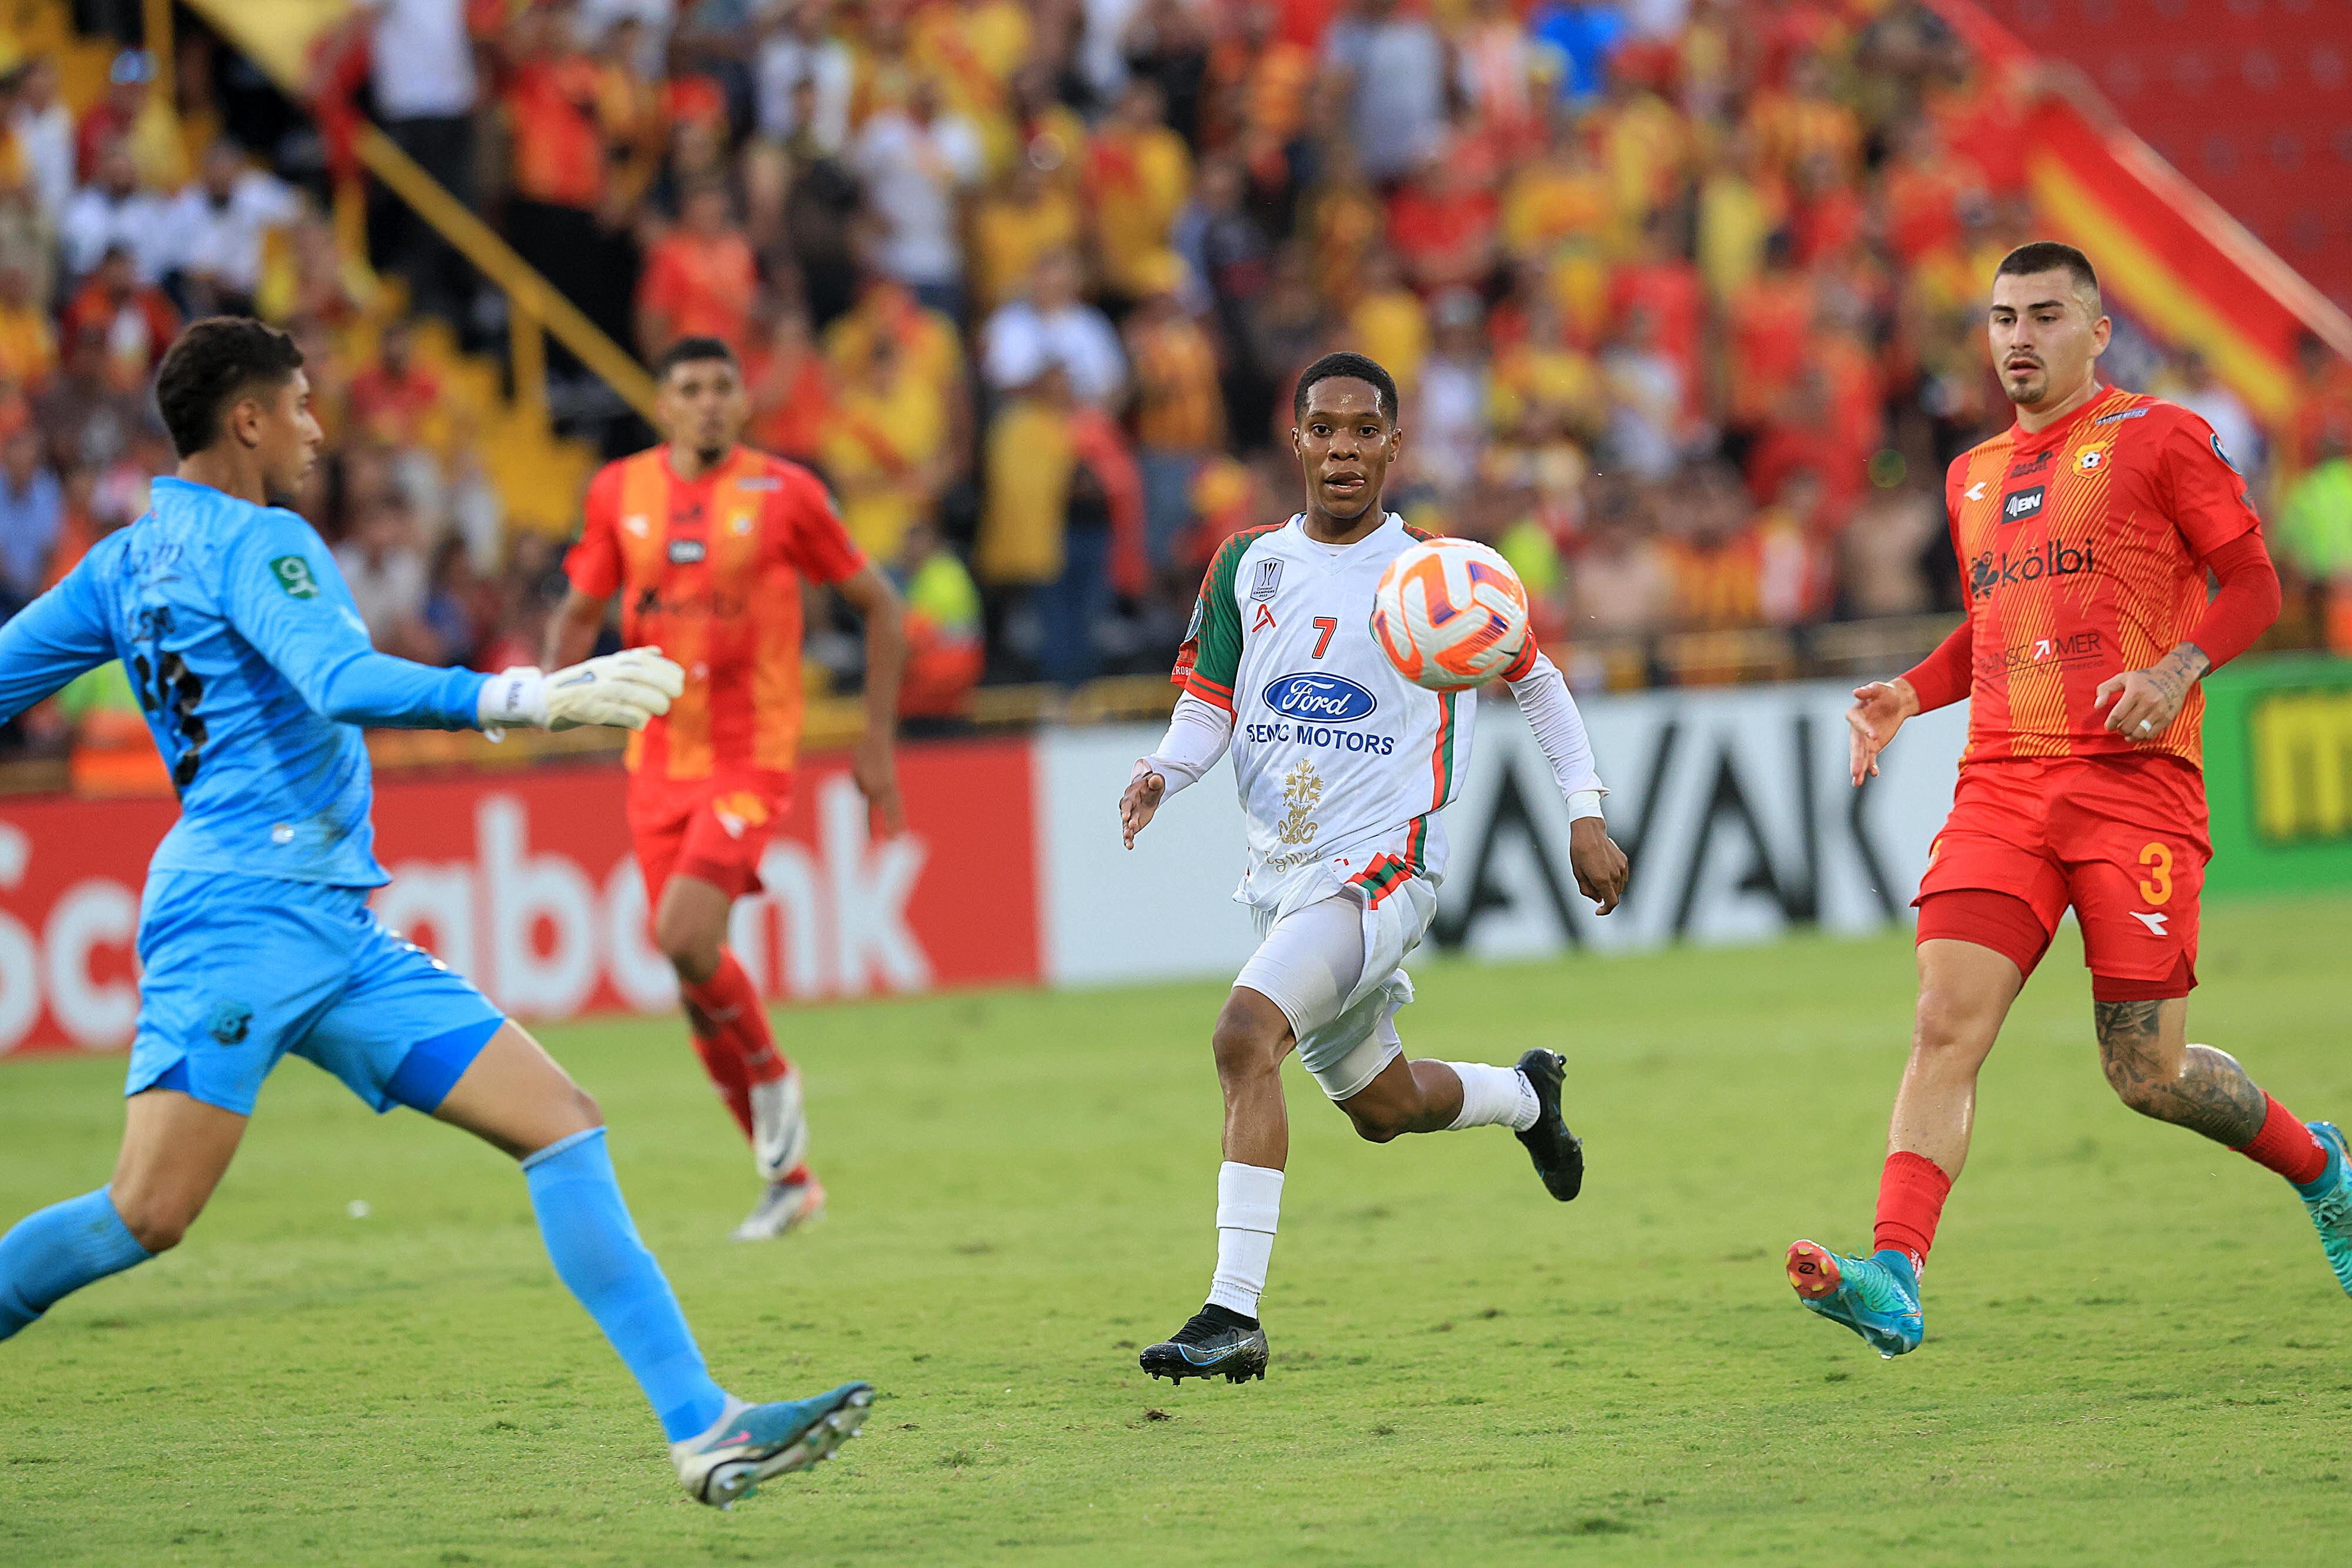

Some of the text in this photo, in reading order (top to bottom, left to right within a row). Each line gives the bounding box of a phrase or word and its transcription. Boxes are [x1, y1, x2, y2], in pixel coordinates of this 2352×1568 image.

[2002, 538, 2093, 587] kölbi
[1312, 616, 1338, 659] 7
[1281, 678, 1352, 716] Ford
[1297, 725, 1395, 755] MOTORS
[1423, 716, 1910, 948] AVAK
[2138, 842, 2174, 906] 3
